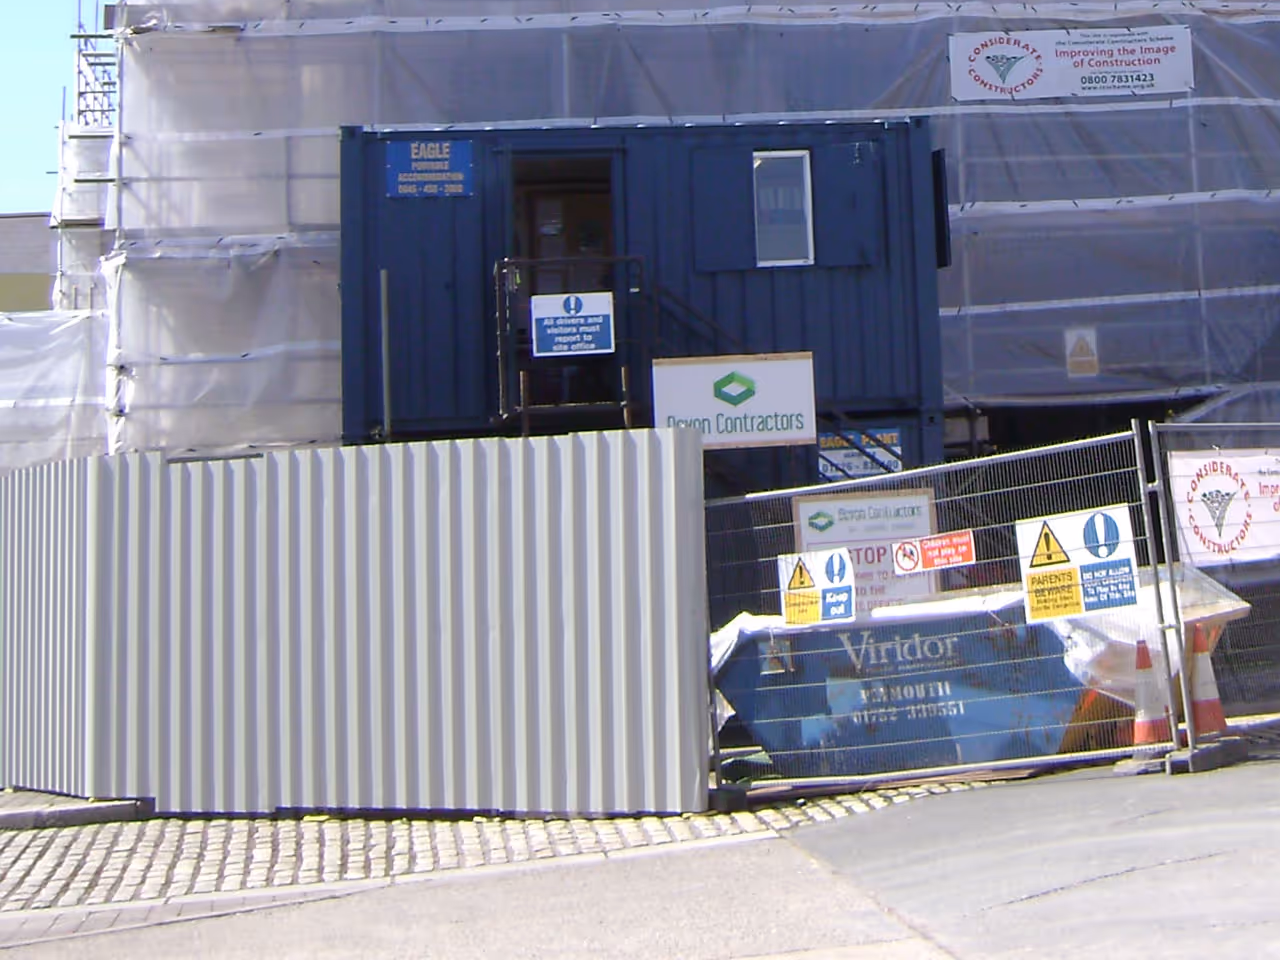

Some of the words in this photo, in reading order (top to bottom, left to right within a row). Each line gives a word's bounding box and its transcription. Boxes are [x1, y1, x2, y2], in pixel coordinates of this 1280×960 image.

[968, 36, 1042, 63] CONSIDERATE
[1055, 47, 1114, 59] Improving
[1117, 46, 1136, 56] the
[1140, 44, 1176, 55] Image
[1073, 58, 1084, 68] of
[1088, 56, 1161, 68] Construction
[968, 67, 1043, 95] CONSTRUCTORS
[1080, 75, 1107, 85] 0800
[1111, 73, 1155, 84] 7831423
[411, 142, 450, 159] EAGLE
[556, 316, 585, 325] drivers
[587, 315, 604, 324] and
[546, 326, 578, 334] visitors
[579, 324, 601, 333] must
[554, 334, 580, 343] report
[583, 333, 593, 342] to
[552, 344, 569, 352] site
[570, 342, 596, 351] office
[716, 411, 804, 434] Contractors
[1186, 460, 1250, 503] CONSIDERATE
[1188, 511, 1253, 554] CONSTRUCTORS
[1031, 572, 1073, 585] PARENTS
[826, 592, 849, 603] Keep
[1034, 584, 1073, 598] BEWARE
[837, 630, 958, 673] Viridor
